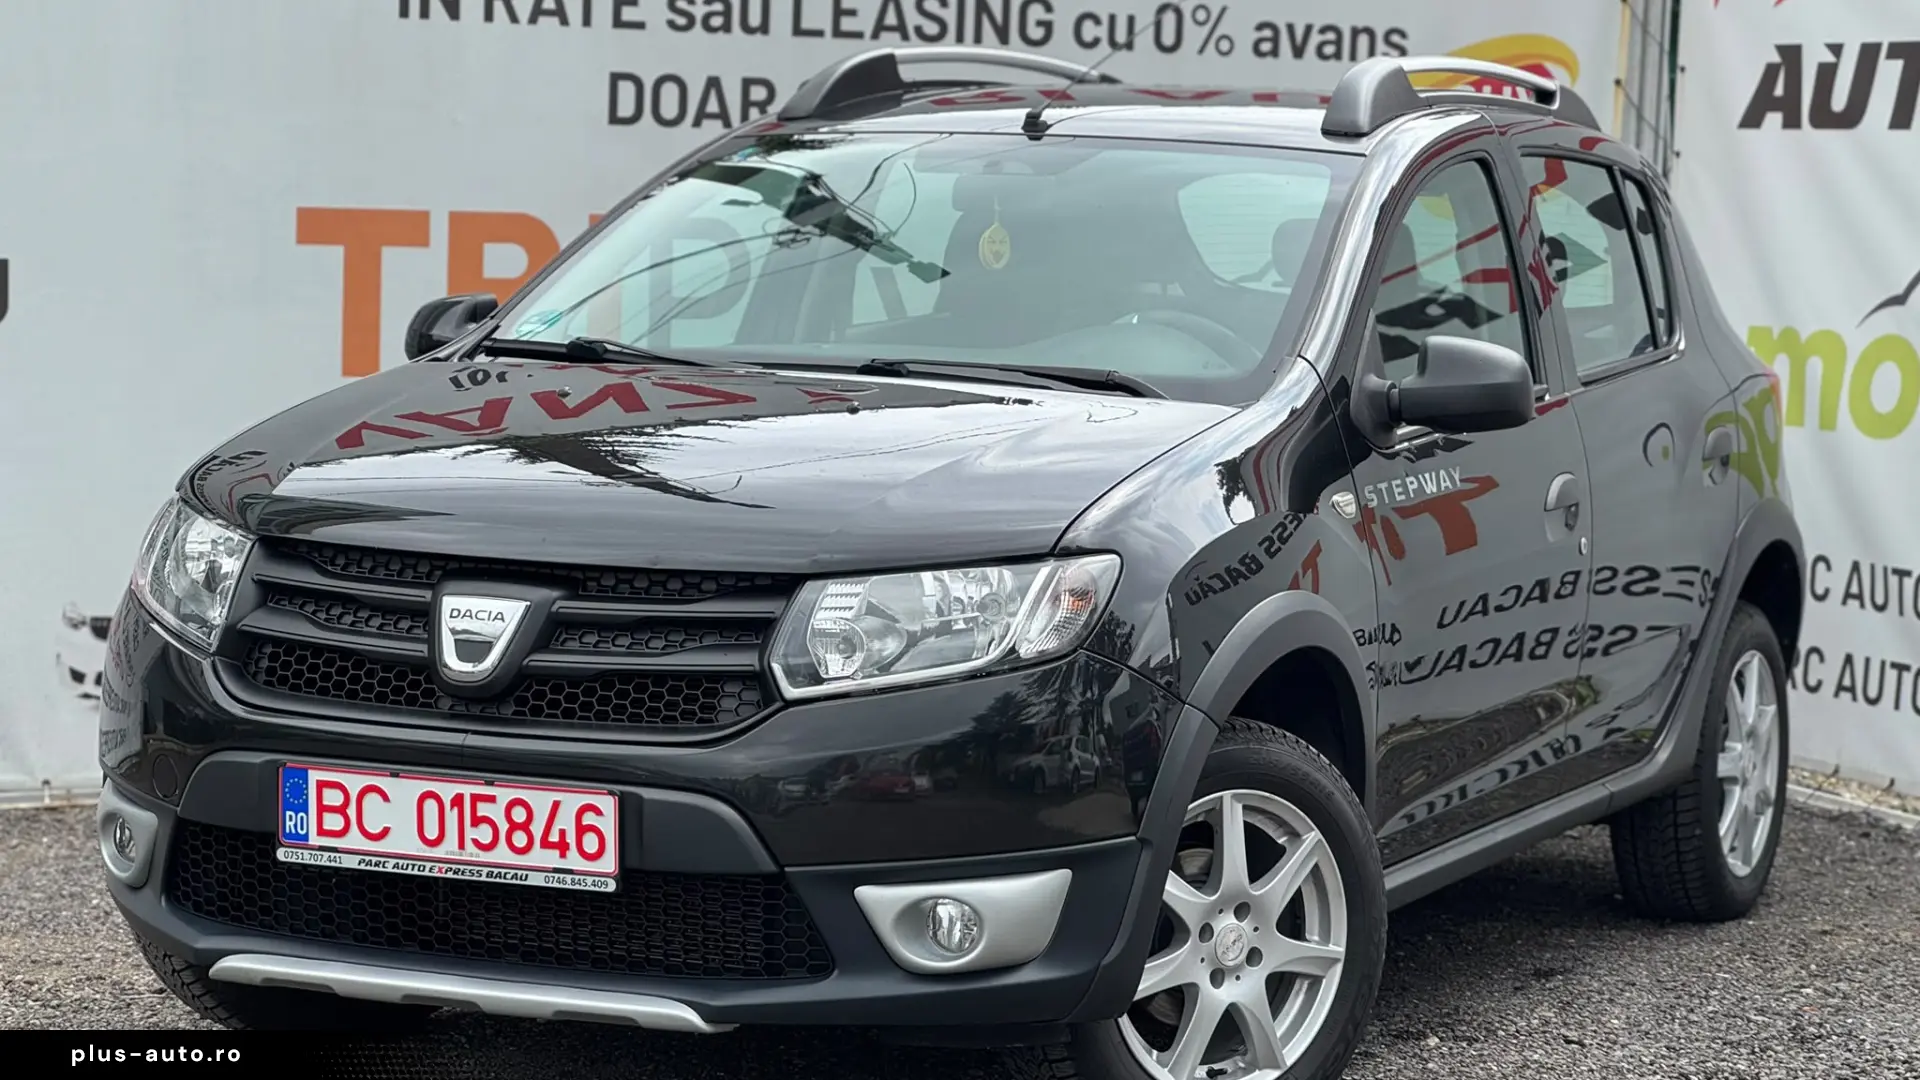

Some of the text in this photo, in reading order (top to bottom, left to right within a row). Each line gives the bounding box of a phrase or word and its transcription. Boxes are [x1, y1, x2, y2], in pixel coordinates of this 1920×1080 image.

[665, 0, 771, 36] sau
[791, 0, 1055, 48] LEASING
[1072, 11, 1136, 52] cu
[1152, 2, 1236, 57] 0%
[1252, 20, 1409, 62] avans
[607, 71, 778, 129] DOAR
[1364, 466, 1462, 509] STEPWAY
[448, 607, 506, 623] DACIA
[285, 810, 308, 835] RO
[315, 779, 606, 862] BC 015846
[283, 849, 609, 889] 0751.707.441 PARC AUTO EXPRESS BACAU 0746.845.409
